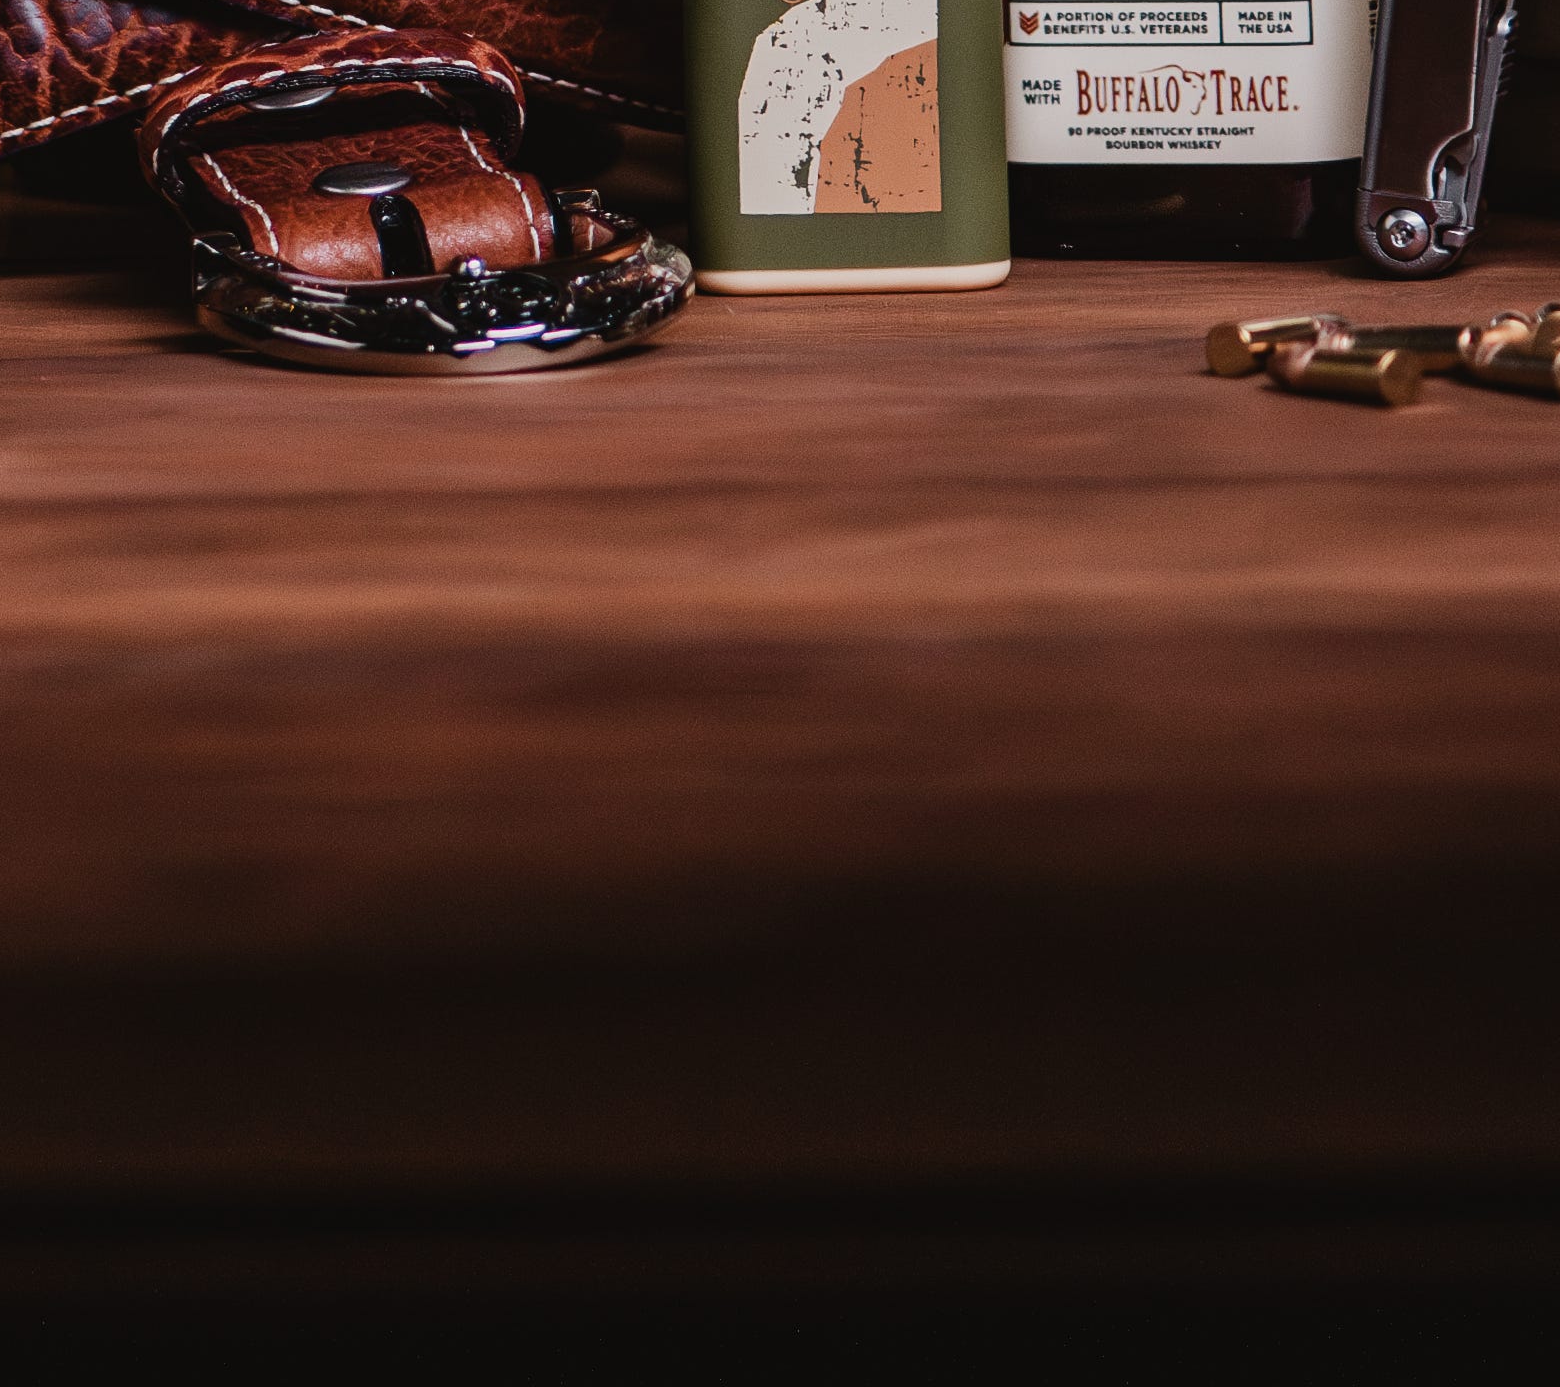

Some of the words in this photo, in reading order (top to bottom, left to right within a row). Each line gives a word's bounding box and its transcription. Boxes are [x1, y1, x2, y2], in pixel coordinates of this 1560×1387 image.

[1043, 11, 1052, 22] A
[1057, 11, 1113, 22] PORTION
[1118, 11, 1136, 22] OF
[1140, 11, 1208, 22] PROCEEDS
[1238, 11, 1274, 22] MADE
[1279, 11, 1293, 22] IN
[1043, 24, 1105, 35] BENEFITS
[1111, 24, 1136, 35] U.S.
[1141, 24, 1208, 35] VETERANS
[1238, 23, 1263, 34] THE
[1266, 23, 1293, 34] USA
[1022, 80, 1062, 91] MADE
[1076, 69, 1181, 115] BUFFALO
[1025, 94, 1061, 105] WITH
[1067, 127, 1082, 137] 90
[1087, 127, 1126, 137] PROOF
[1131, 127, 1192, 137] KENTUCKY
[1197, 127, 1255, 137] STRAIGHT
[1106, 140, 1164, 150] BOURBON
[1167, 140, 1222, 150] WHISKEY
